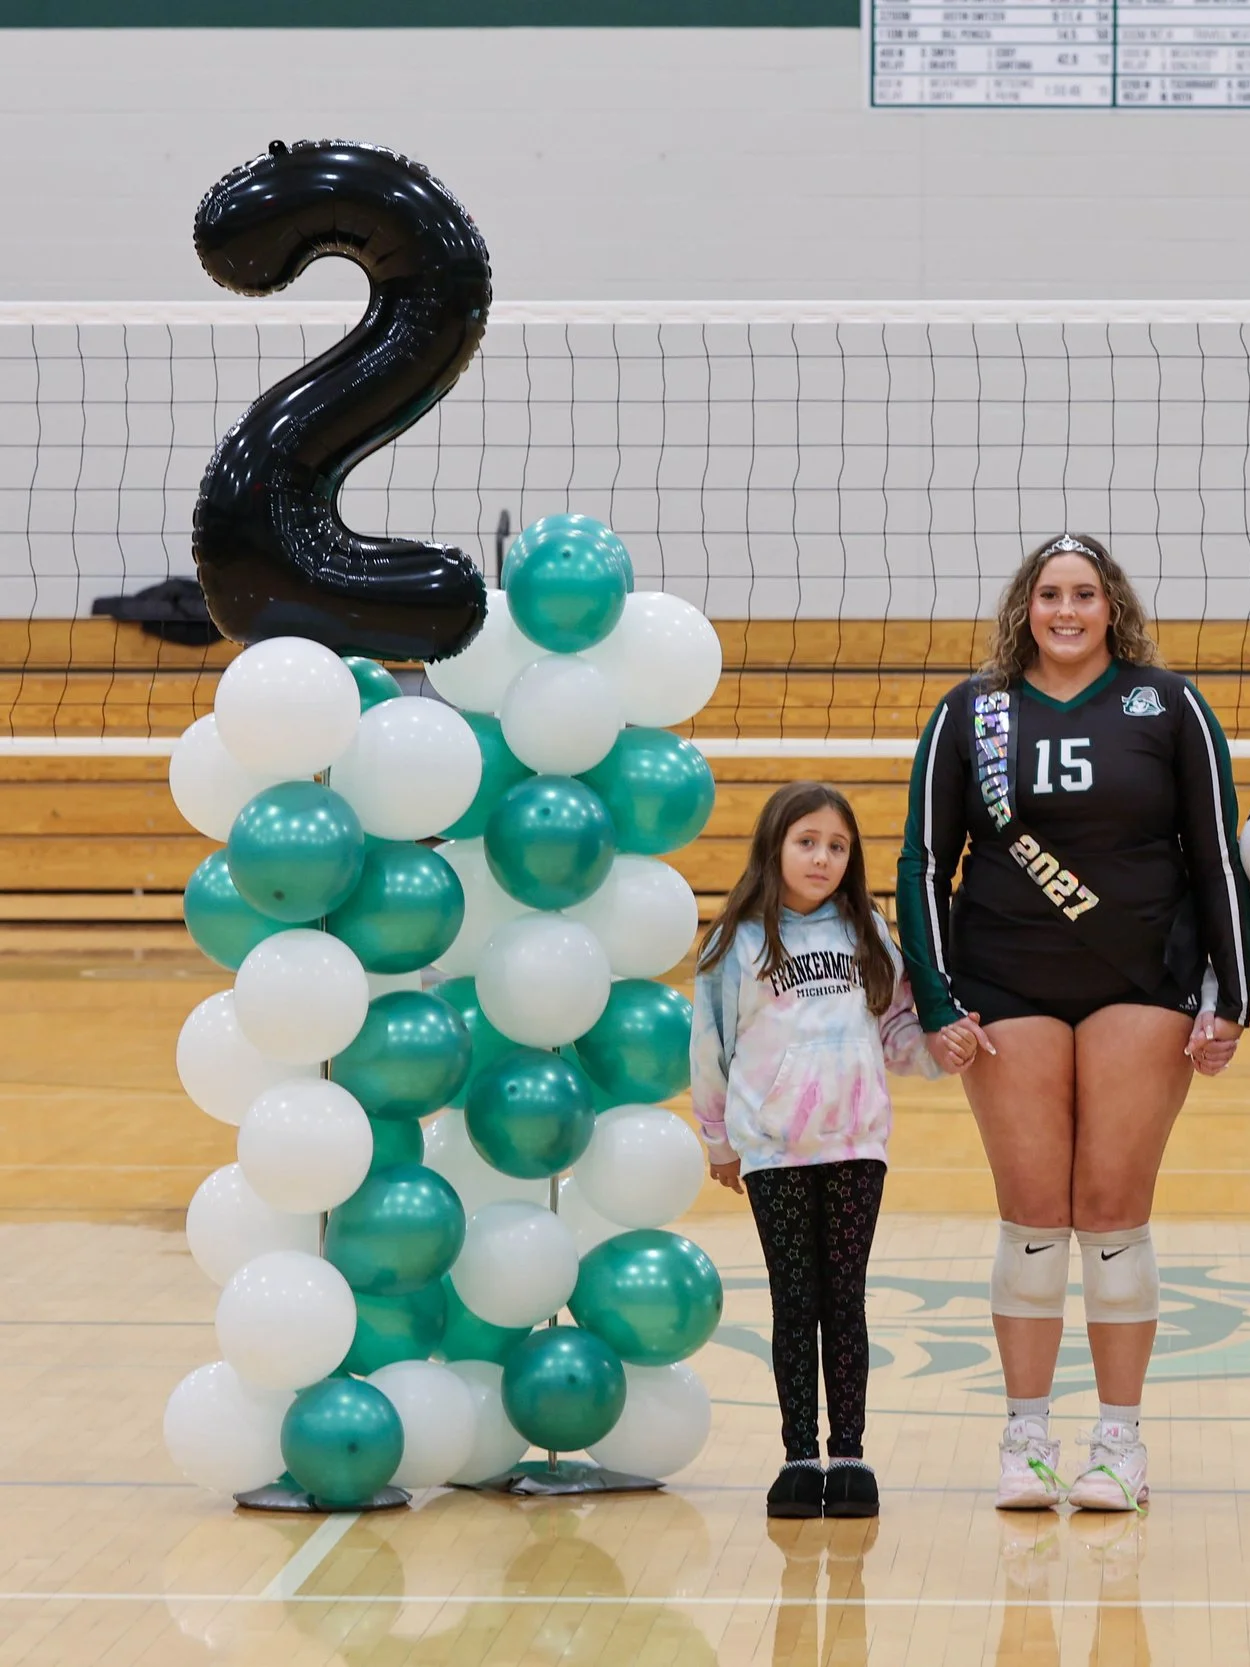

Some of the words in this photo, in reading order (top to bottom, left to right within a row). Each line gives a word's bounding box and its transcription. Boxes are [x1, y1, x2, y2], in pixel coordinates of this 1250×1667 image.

[194, 138, 492, 662] 2
[974, 690, 1012, 833] SENIOR
[1033, 737, 1093, 794] 15
[1008, 834, 1100, 922] 2027
[796, 984, 851, 999] MICHIGAN
